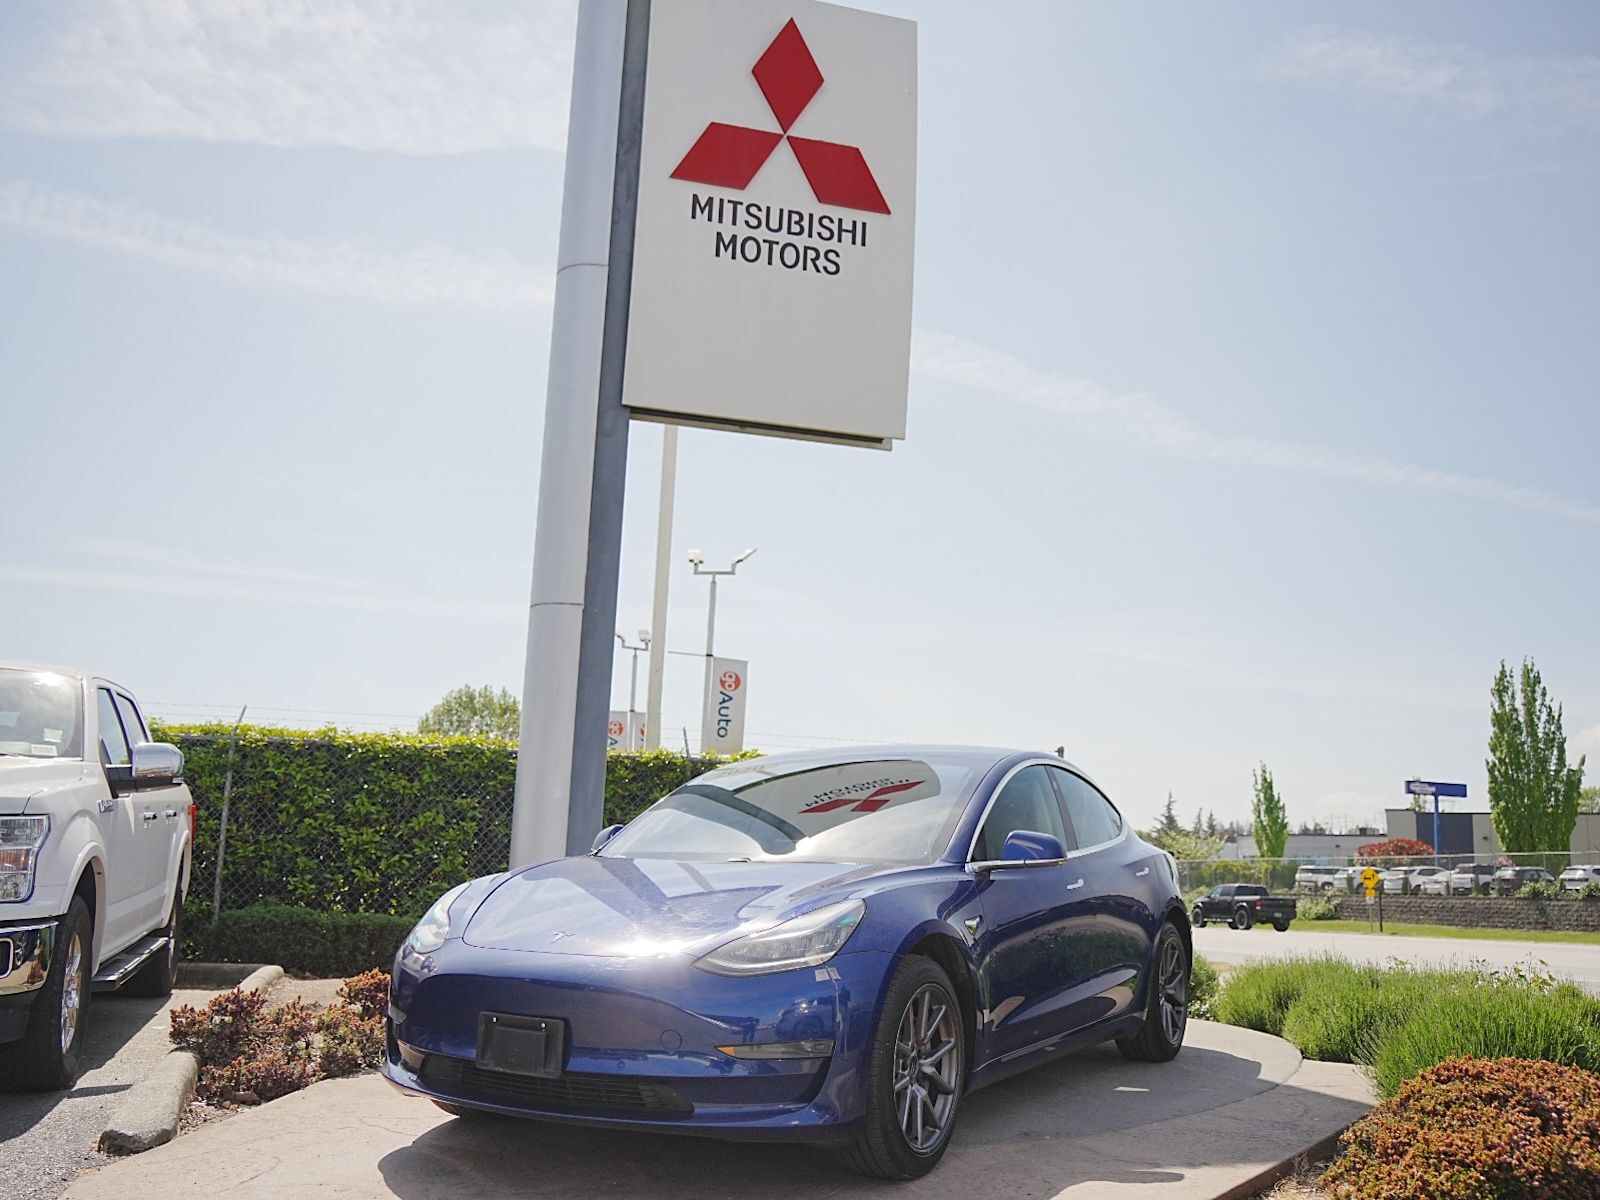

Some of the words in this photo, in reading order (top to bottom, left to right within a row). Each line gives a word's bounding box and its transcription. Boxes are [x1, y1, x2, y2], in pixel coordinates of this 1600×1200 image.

[691, 194, 867, 247] MITSUBISHI
[714, 231, 841, 275] MOTORS
[720, 671, 741, 691] go
[717, 691, 733, 738] Auto
